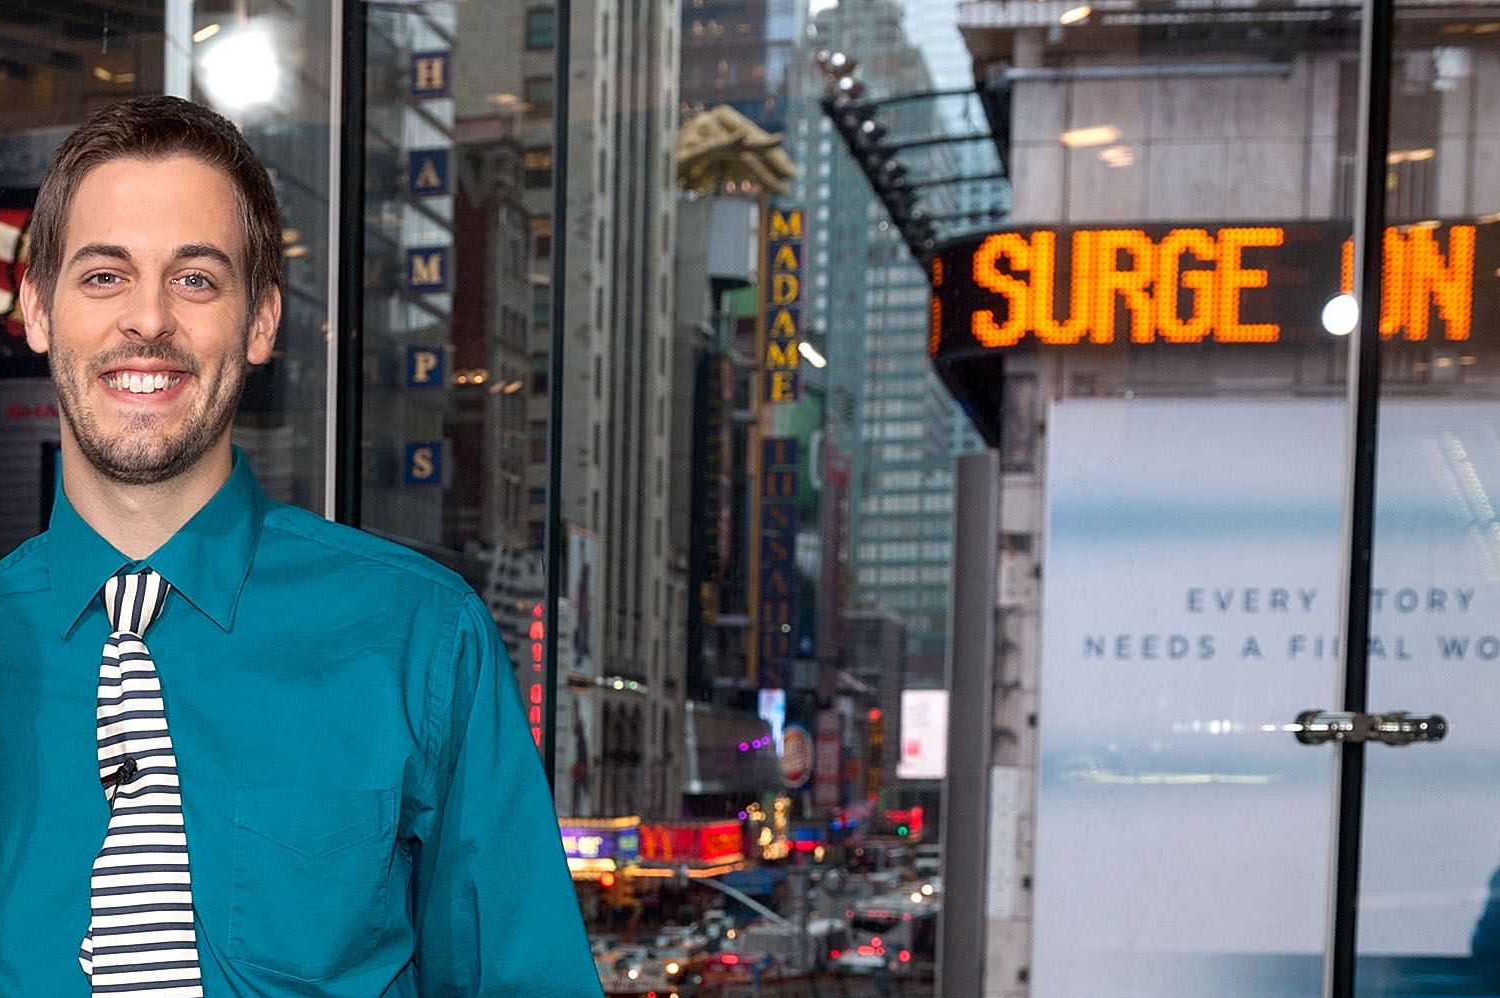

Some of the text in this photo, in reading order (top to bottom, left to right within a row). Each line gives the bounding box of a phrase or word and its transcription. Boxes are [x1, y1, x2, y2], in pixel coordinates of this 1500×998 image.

[766, 209, 802, 402] MADAME
[971, 227, 1284, 347] SURGE
[1185, 587, 1476, 614] EVERY TORY
[1083, 634, 1500, 661] NEEDS A FIAL WO
